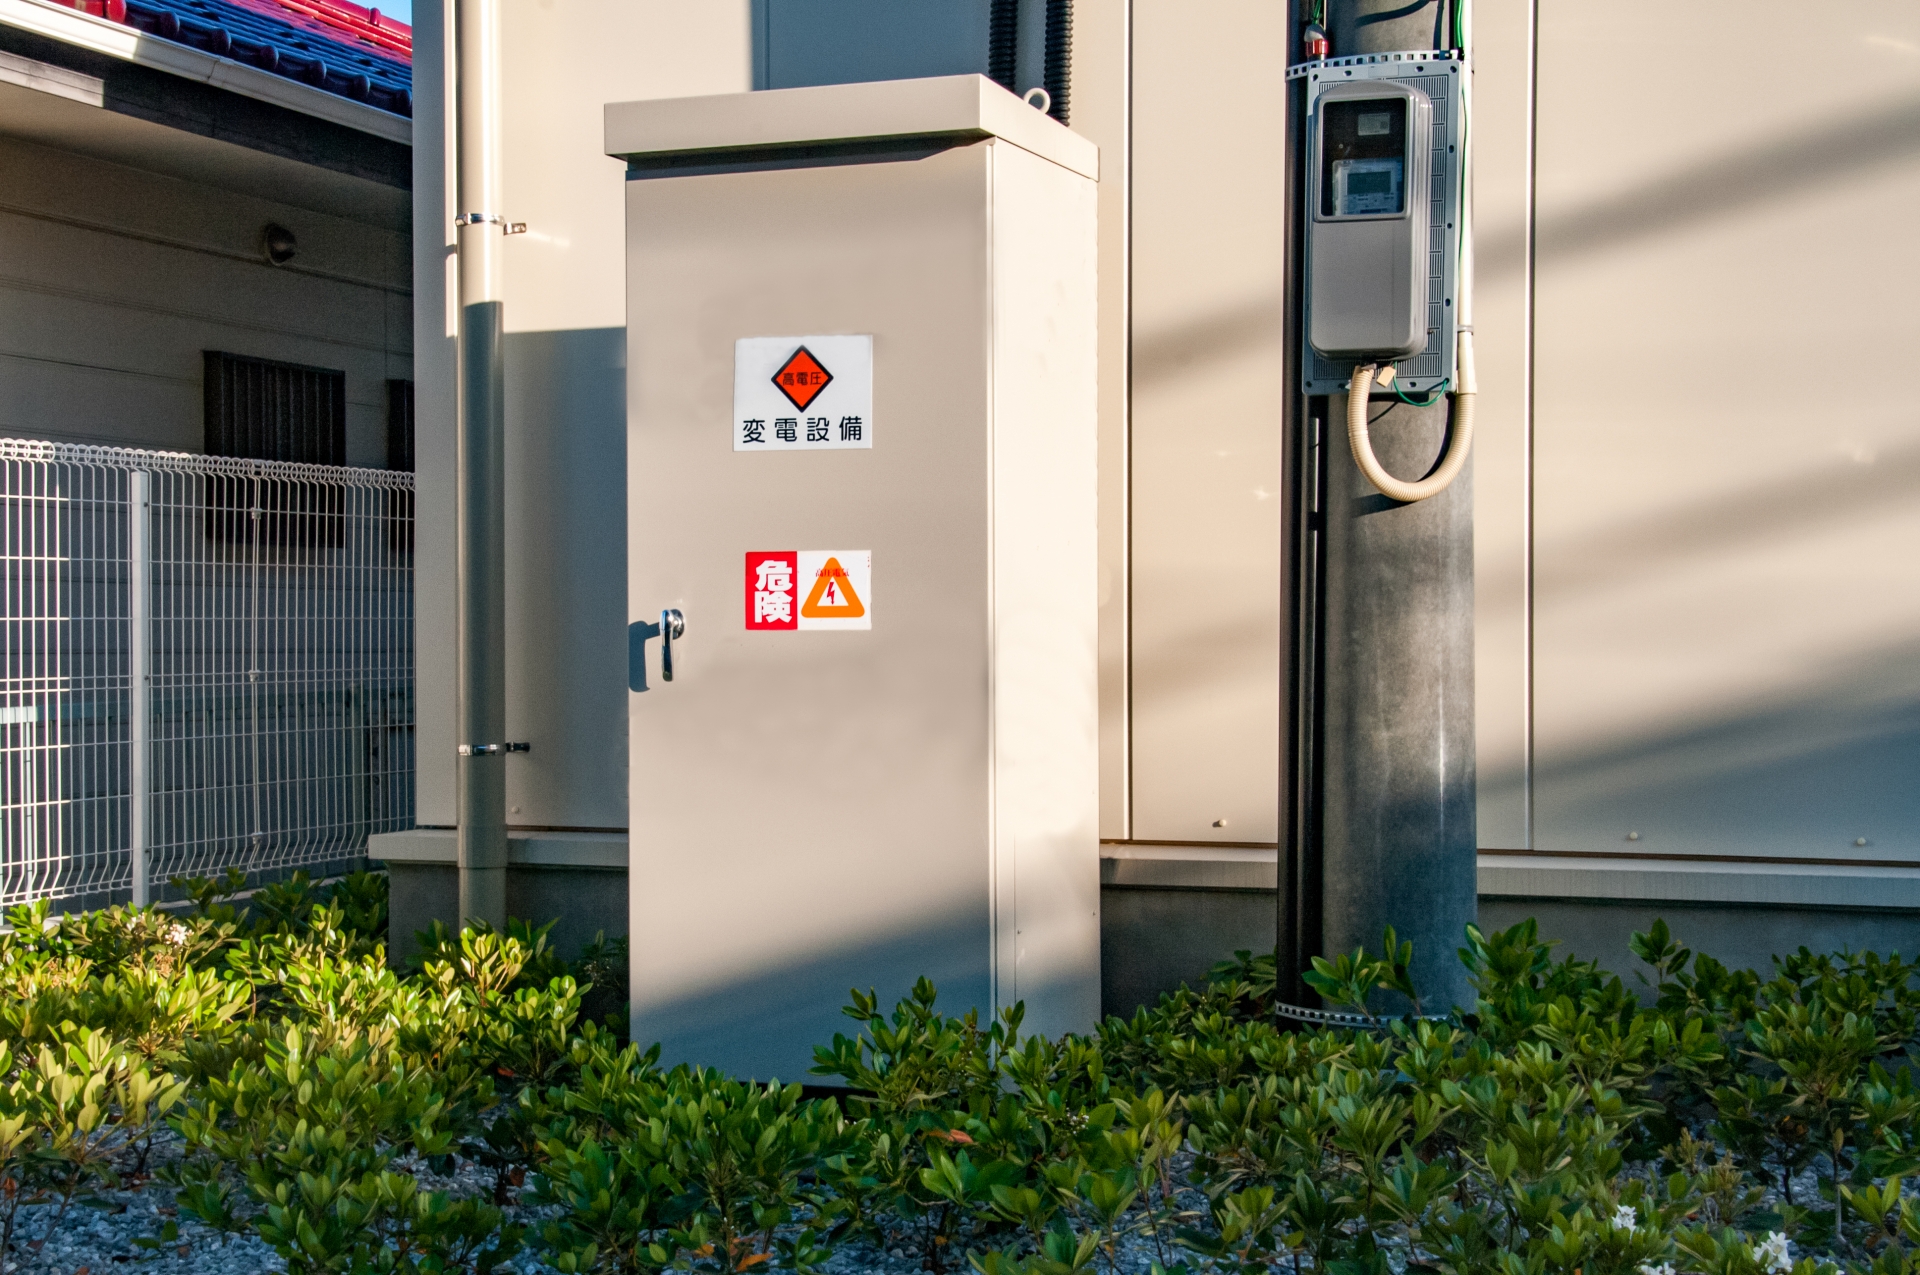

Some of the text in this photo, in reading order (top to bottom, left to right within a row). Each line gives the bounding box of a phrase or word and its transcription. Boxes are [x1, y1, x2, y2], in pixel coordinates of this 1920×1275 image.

[782, 371, 822, 386] 高電圧
[742, 416, 862, 444] 変電設備
[754, 559, 793, 623] 危険
